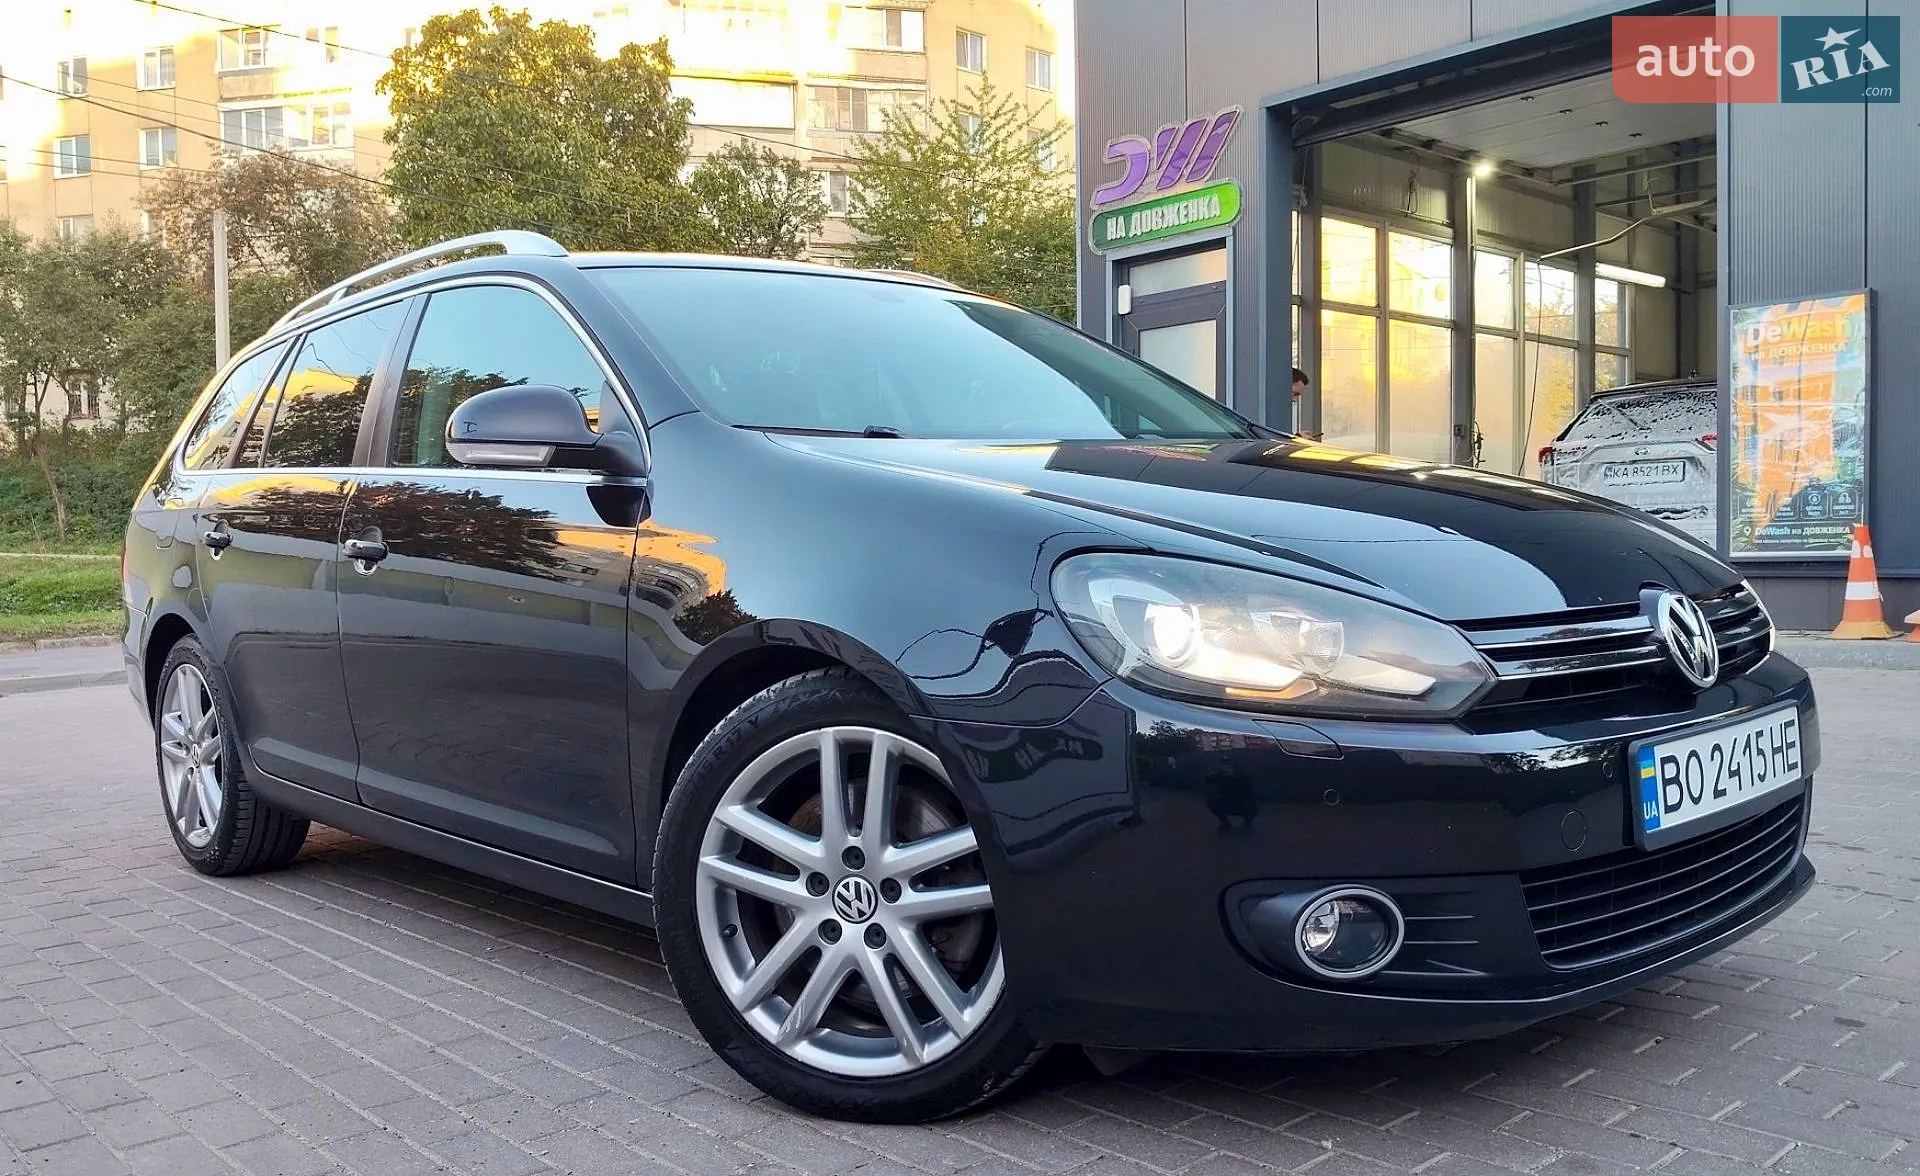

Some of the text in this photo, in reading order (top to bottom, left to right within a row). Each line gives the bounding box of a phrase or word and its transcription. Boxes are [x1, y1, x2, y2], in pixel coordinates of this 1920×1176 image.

[1106, 194, 1221, 241] НА ДОВЖЕНКА
[1769, 342, 1847, 358] ДОВЖЕНКА
[1659, 718, 1799, 815] BO 2415 HE
[1643, 801, 1659, 820] UA
